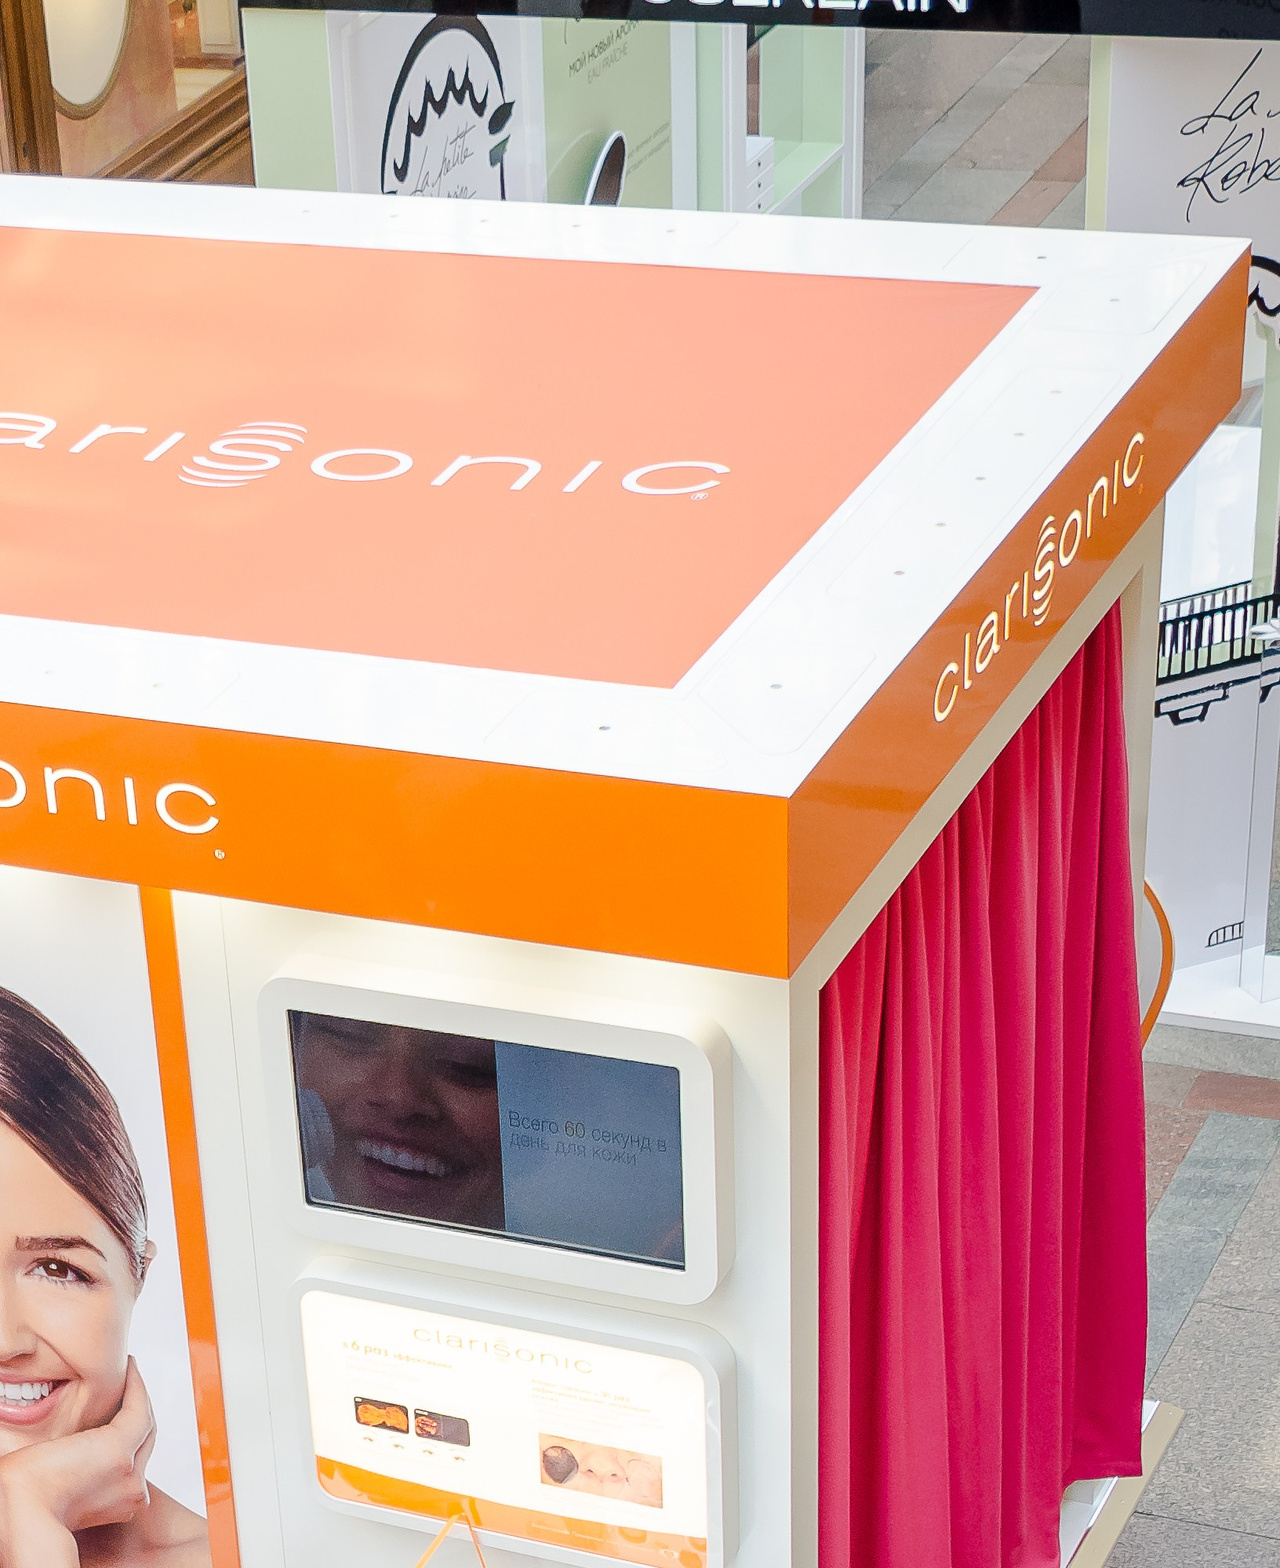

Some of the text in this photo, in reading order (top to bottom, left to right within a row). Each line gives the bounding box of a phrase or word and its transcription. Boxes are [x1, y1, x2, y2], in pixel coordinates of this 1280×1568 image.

[1180, 47, 1262, 136] La
[932, 431, 1145, 723] clarisonic
[507, 1109, 560, 1136] Всего
[563, 1120, 587, 1140] 60
[590, 1127, 652, 1153] секунд
[508, 1133, 638, 1167] день для кожи
[413, 1328, 594, 1374] clarisonic
